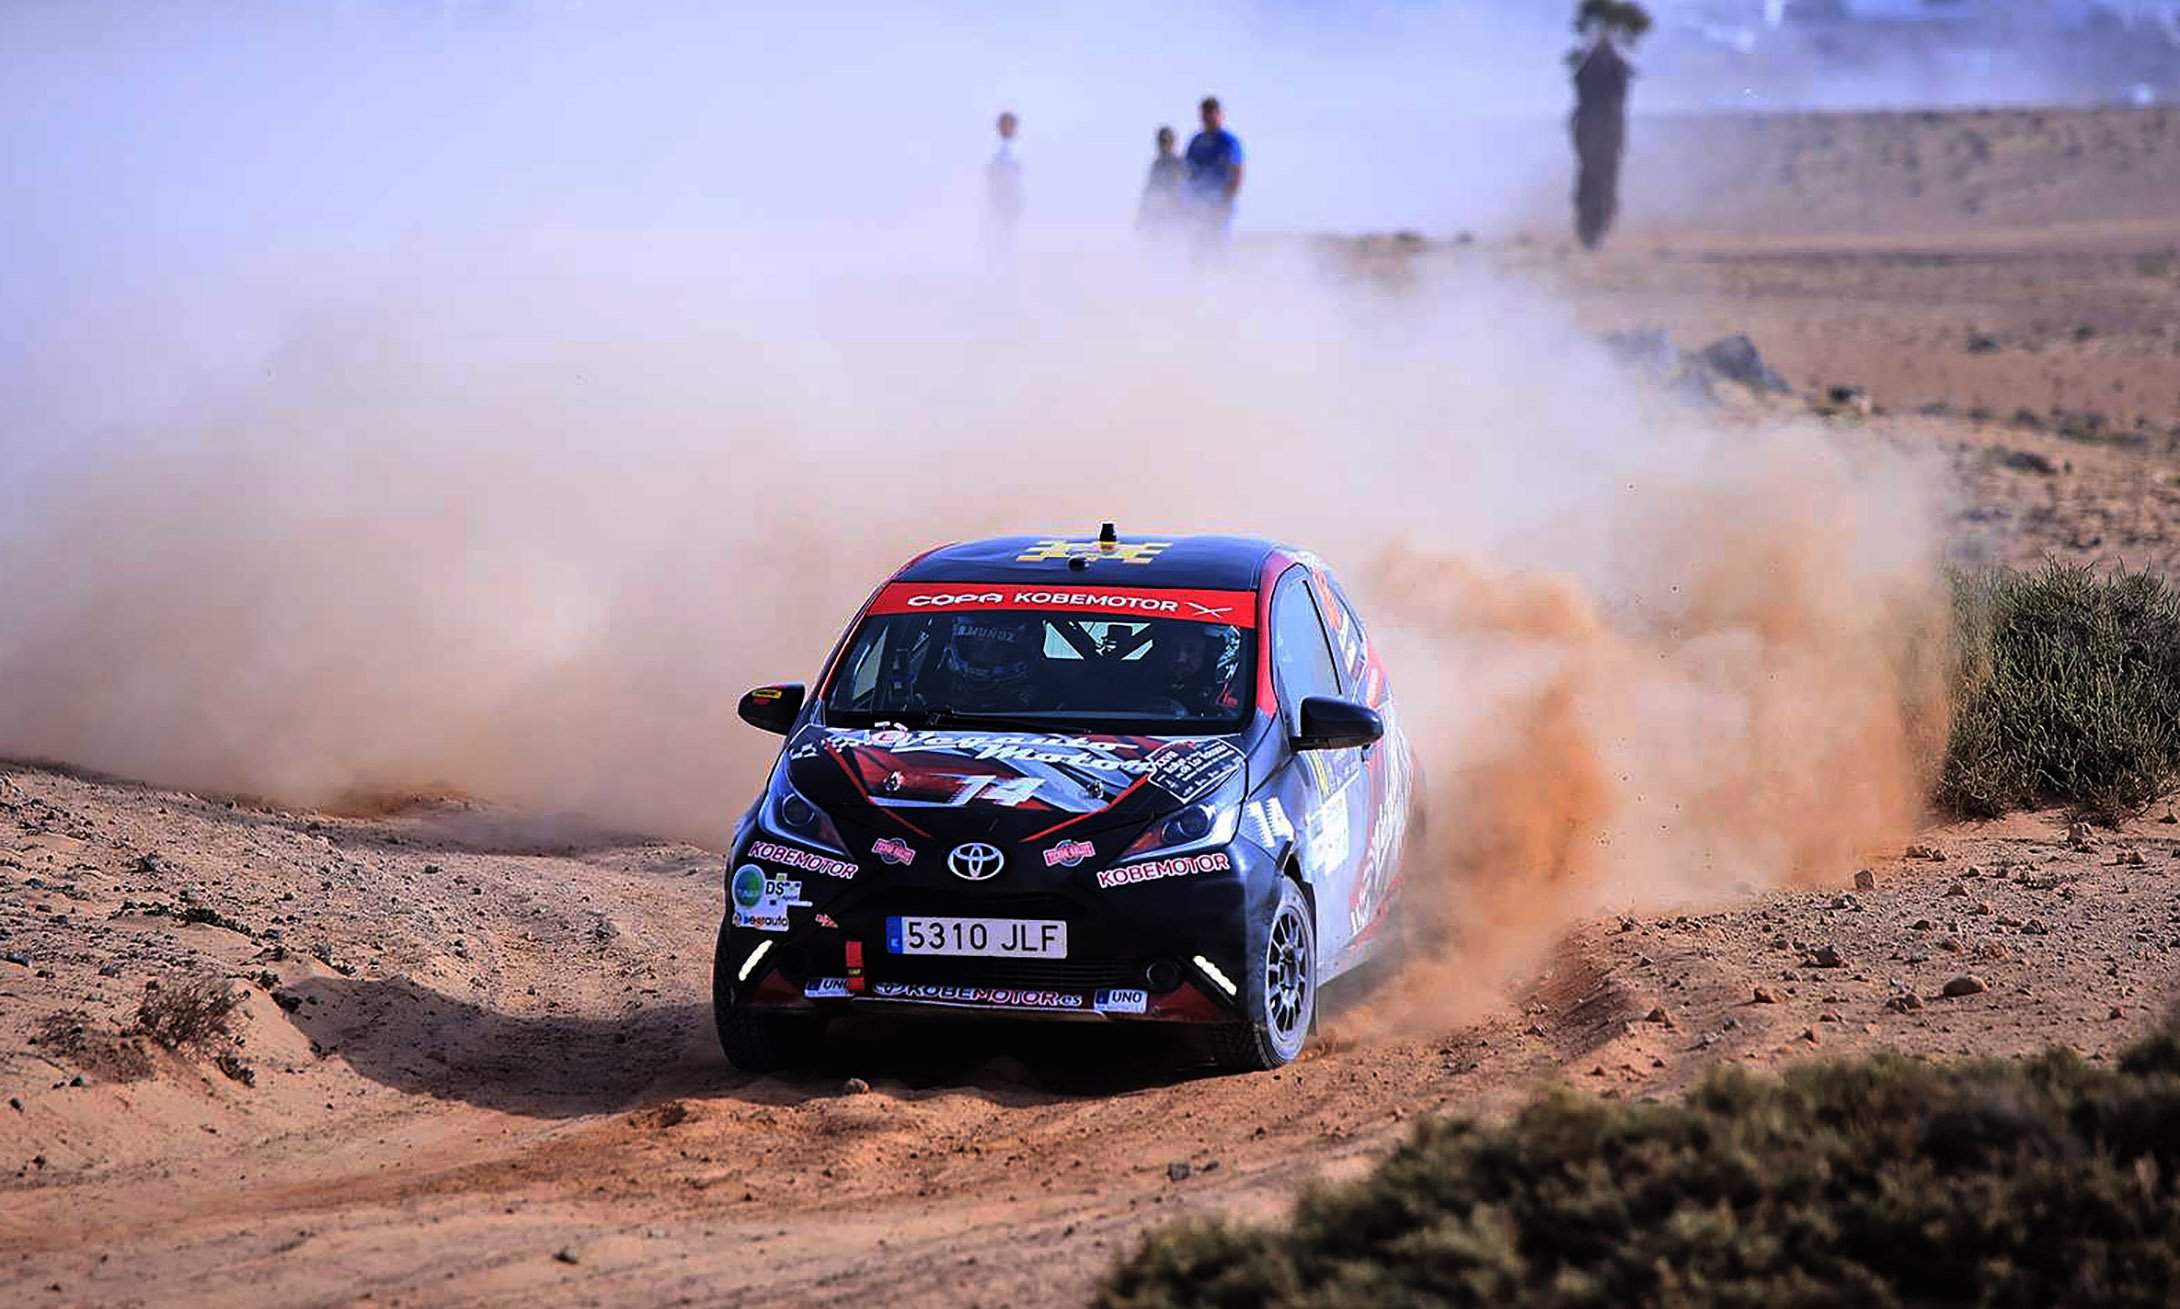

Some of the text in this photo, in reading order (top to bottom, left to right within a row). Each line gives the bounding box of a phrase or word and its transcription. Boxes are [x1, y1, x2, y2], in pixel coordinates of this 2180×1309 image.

[907, 592, 1179, 612] COPA KOBEMOTOR
[748, 841, 858, 879] KOBEMOTOR
[1096, 853, 1230, 888] KOBEMOTOR
[908, 921, 1059, 952] 5310 JLF
[1112, 991, 1143, 1004] UNO
